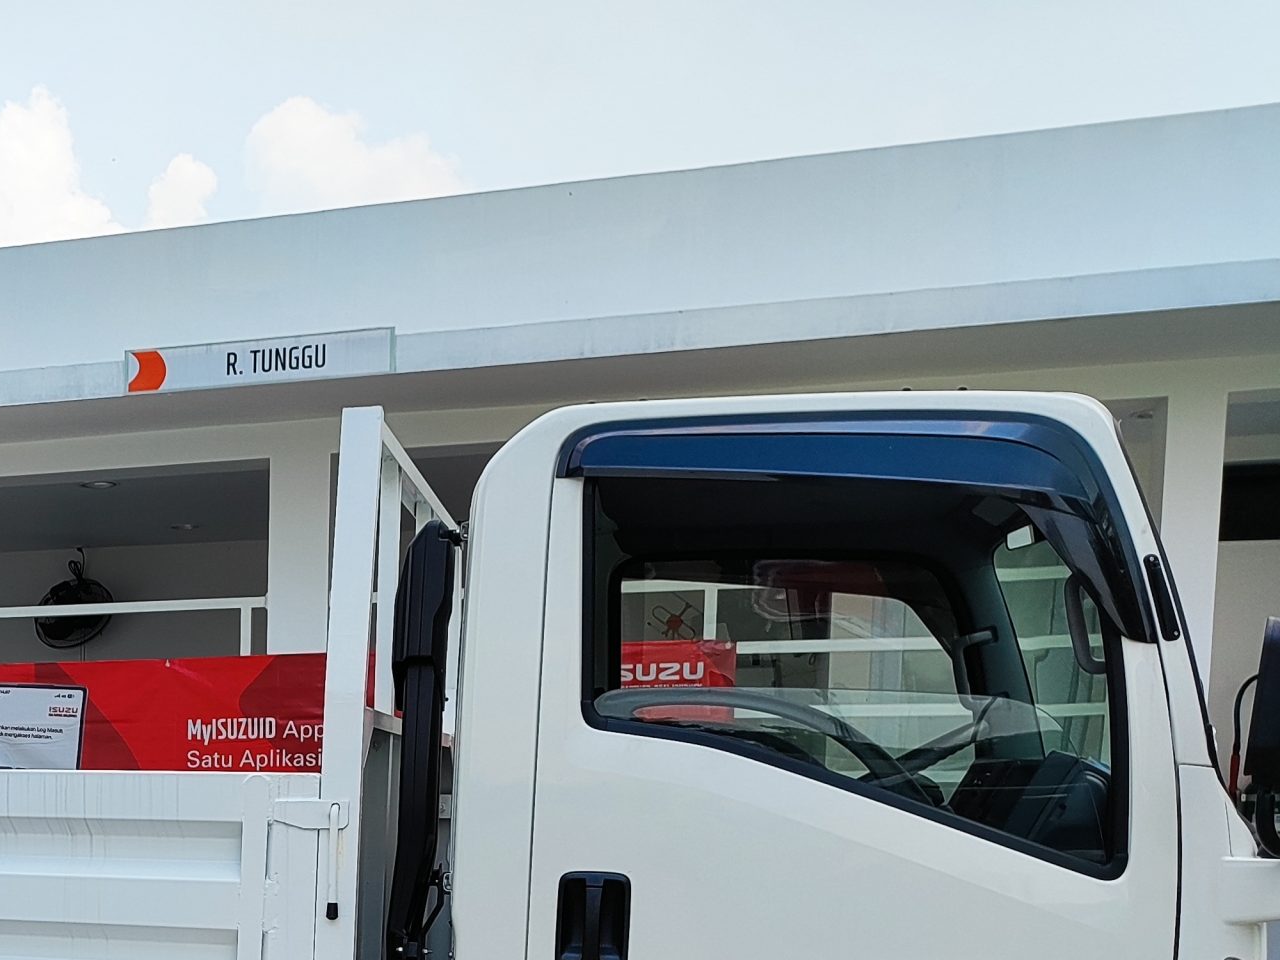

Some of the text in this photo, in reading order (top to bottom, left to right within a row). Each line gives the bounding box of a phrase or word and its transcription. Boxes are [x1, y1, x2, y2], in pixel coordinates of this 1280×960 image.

[226, 343, 327, 375] R. TUNGGU
[621, 661, 705, 682] SUZU
[187, 717, 277, 745] MyISUZUID
[187, 748, 322, 771] Satu Aplikasi
